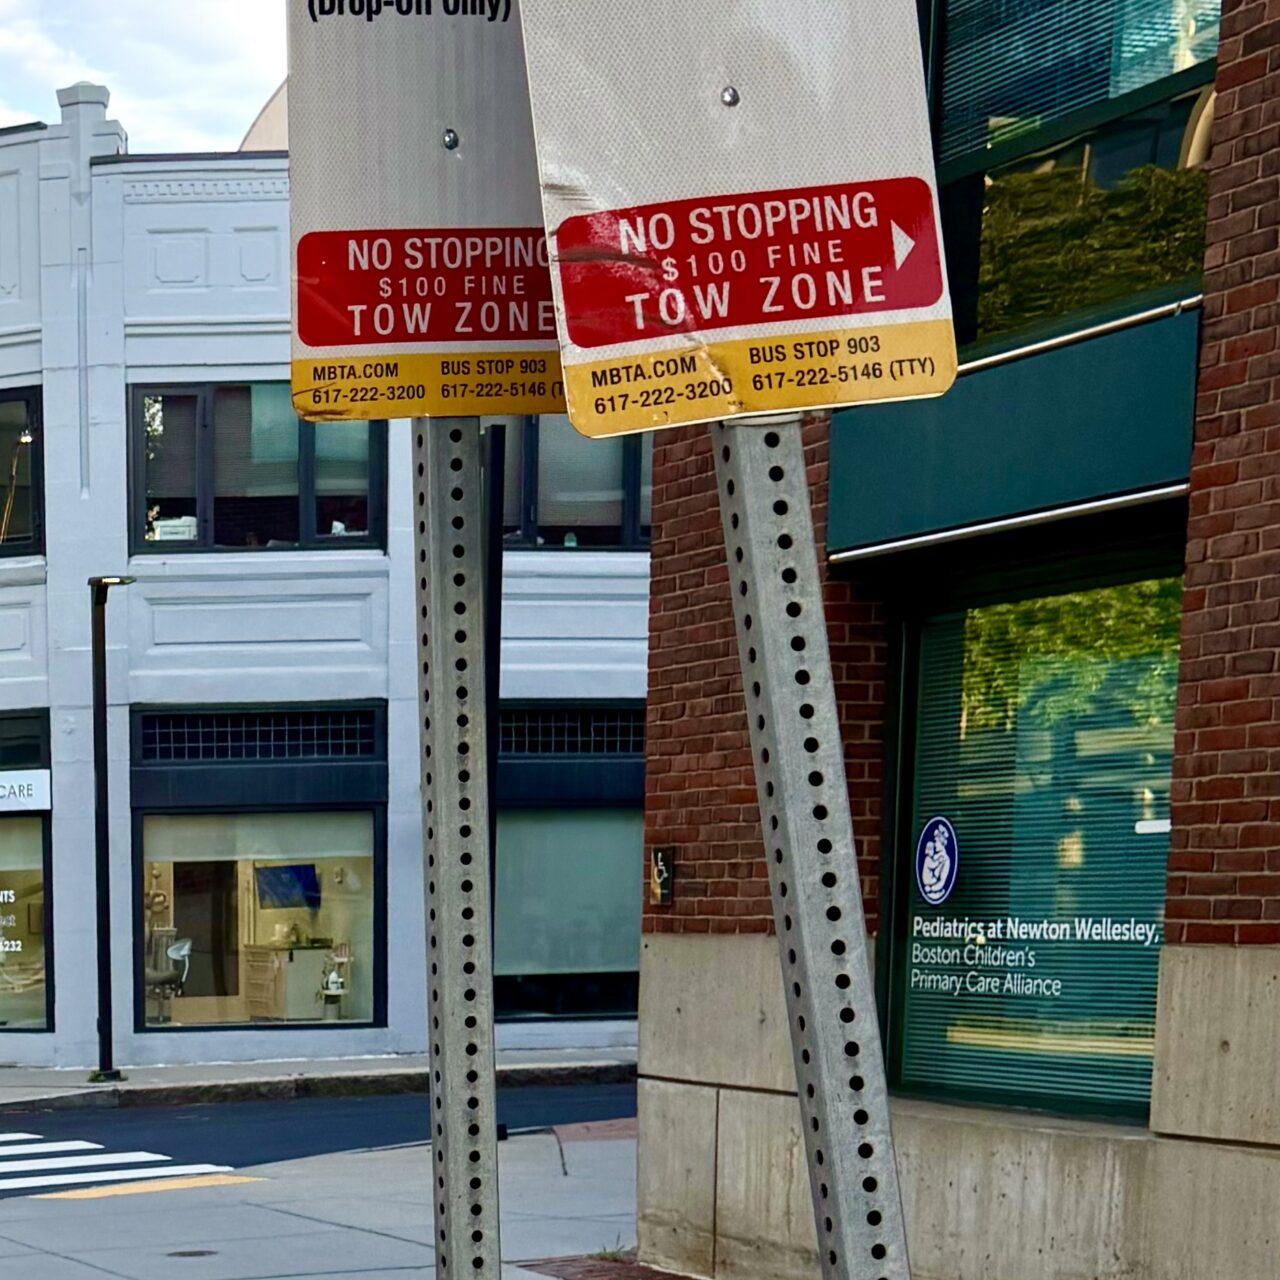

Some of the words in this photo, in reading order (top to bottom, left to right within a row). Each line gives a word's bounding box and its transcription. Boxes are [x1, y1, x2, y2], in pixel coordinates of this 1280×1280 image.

[619, 212, 675, 255] NO
[690, 191, 878, 245] STOPPING
[347, 238, 392, 271] NO
[662, 249, 747, 281] $100
[767, 239, 844, 269] FINE
[379, 277, 446, 299] $100
[464, 275, 525, 296] FINE
[625, 281, 731, 331] TOW
[759, 265, 886, 314] ZONE
[347, 302, 432, 336] TOW
[455, 301, 555, 333] ZONE
[749, 344, 787, 365] BUS
[793, 340, 840, 361] STOP
[847, 335, 881, 355] 903
[312, 363, 399, 382] MBTA.COM
[440, 360, 471, 376] BUS
[476, 359, 514, 375] STOP
[519, 359, 547, 375] 903
[591, 356, 697, 388] MBTA.COM
[752, 362, 883, 392] 617-222-5146
[890, 356, 935, 381] (TTY)
[312, 384, 426, 404] 617-222-3200
[440, 382, 546, 399] 617-222-5146
[594, 377, 733, 415] 617-222-3200
[912, 916, 984, 938] Pediatrics
[987, 919, 1004, 938] at
[1006, 918, 1070, 940] Newton
[1074, 918, 1160, 946] Wellesley,
[912, 943, 960, 964] Boston
[910, 969, 963, 996] Primary
[966, 972, 999, 993] Care
[1003, 972, 1062, 996] Alliance
